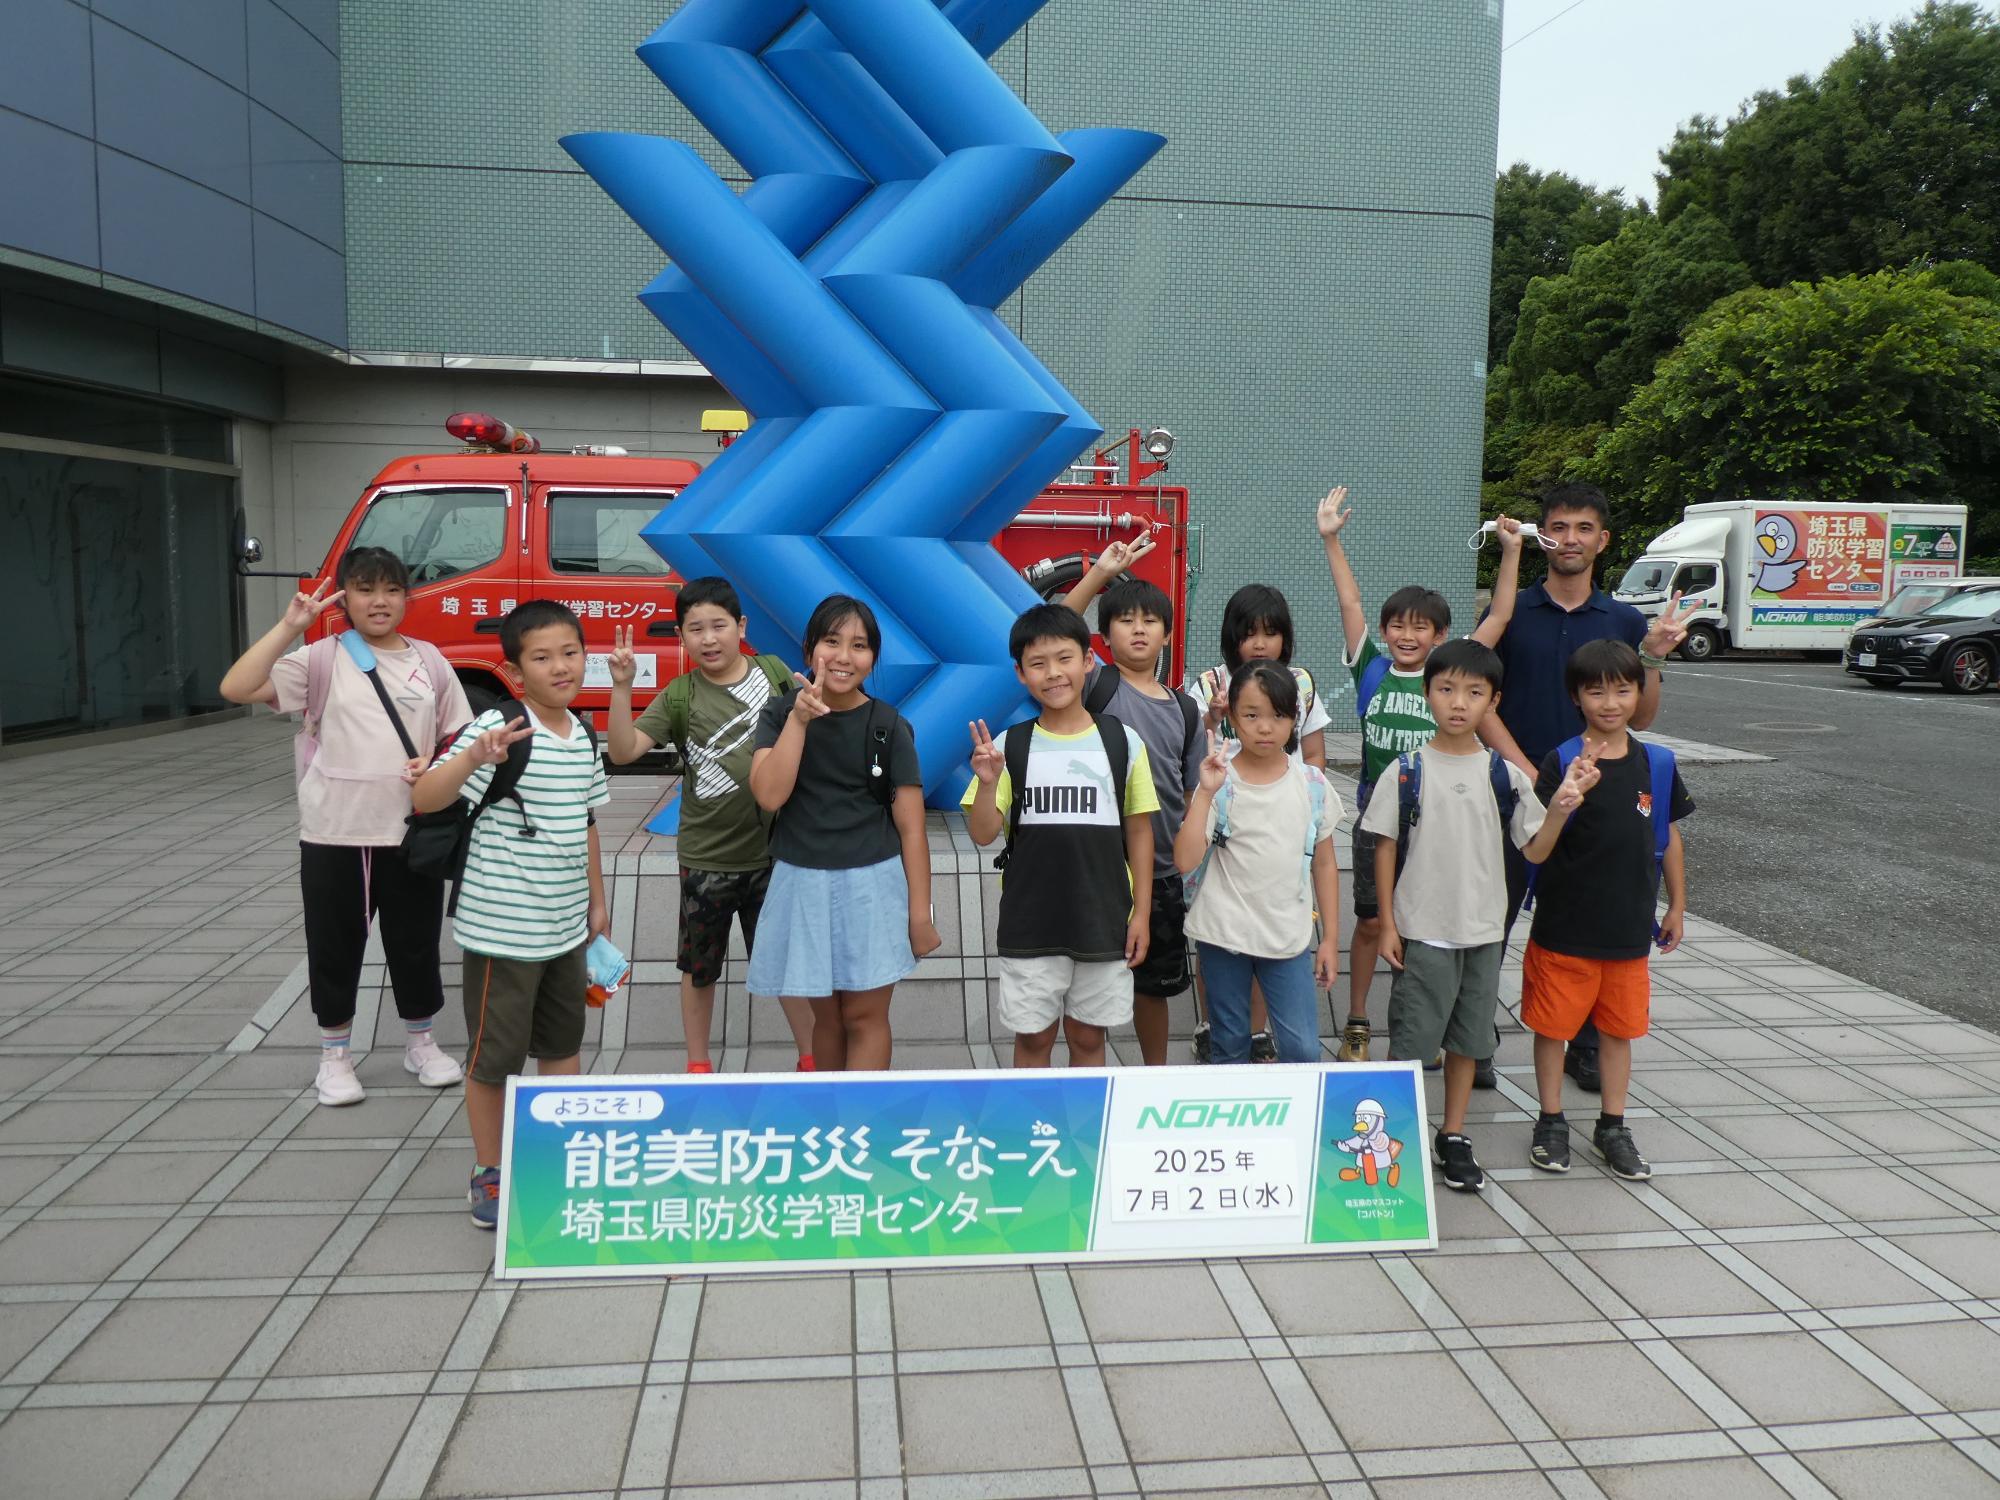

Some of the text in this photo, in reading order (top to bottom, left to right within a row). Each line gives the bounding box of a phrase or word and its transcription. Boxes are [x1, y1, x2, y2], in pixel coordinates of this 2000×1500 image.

[1809, 516, 1867, 537] 埼玉県
[1807, 538, 1884, 559] 防災学習
[1806, 560, 1883, 580] センター
[1755, 611, 1808, 622] NOHMI
[1023, 785, 1098, 815] PUMA
[1136, 1097, 1293, 1130] NOHMI
[564, 1120, 1078, 1189] 能美防災 そなーえ
[560, 1191, 1023, 1245] 埼玉県防災学習センター
